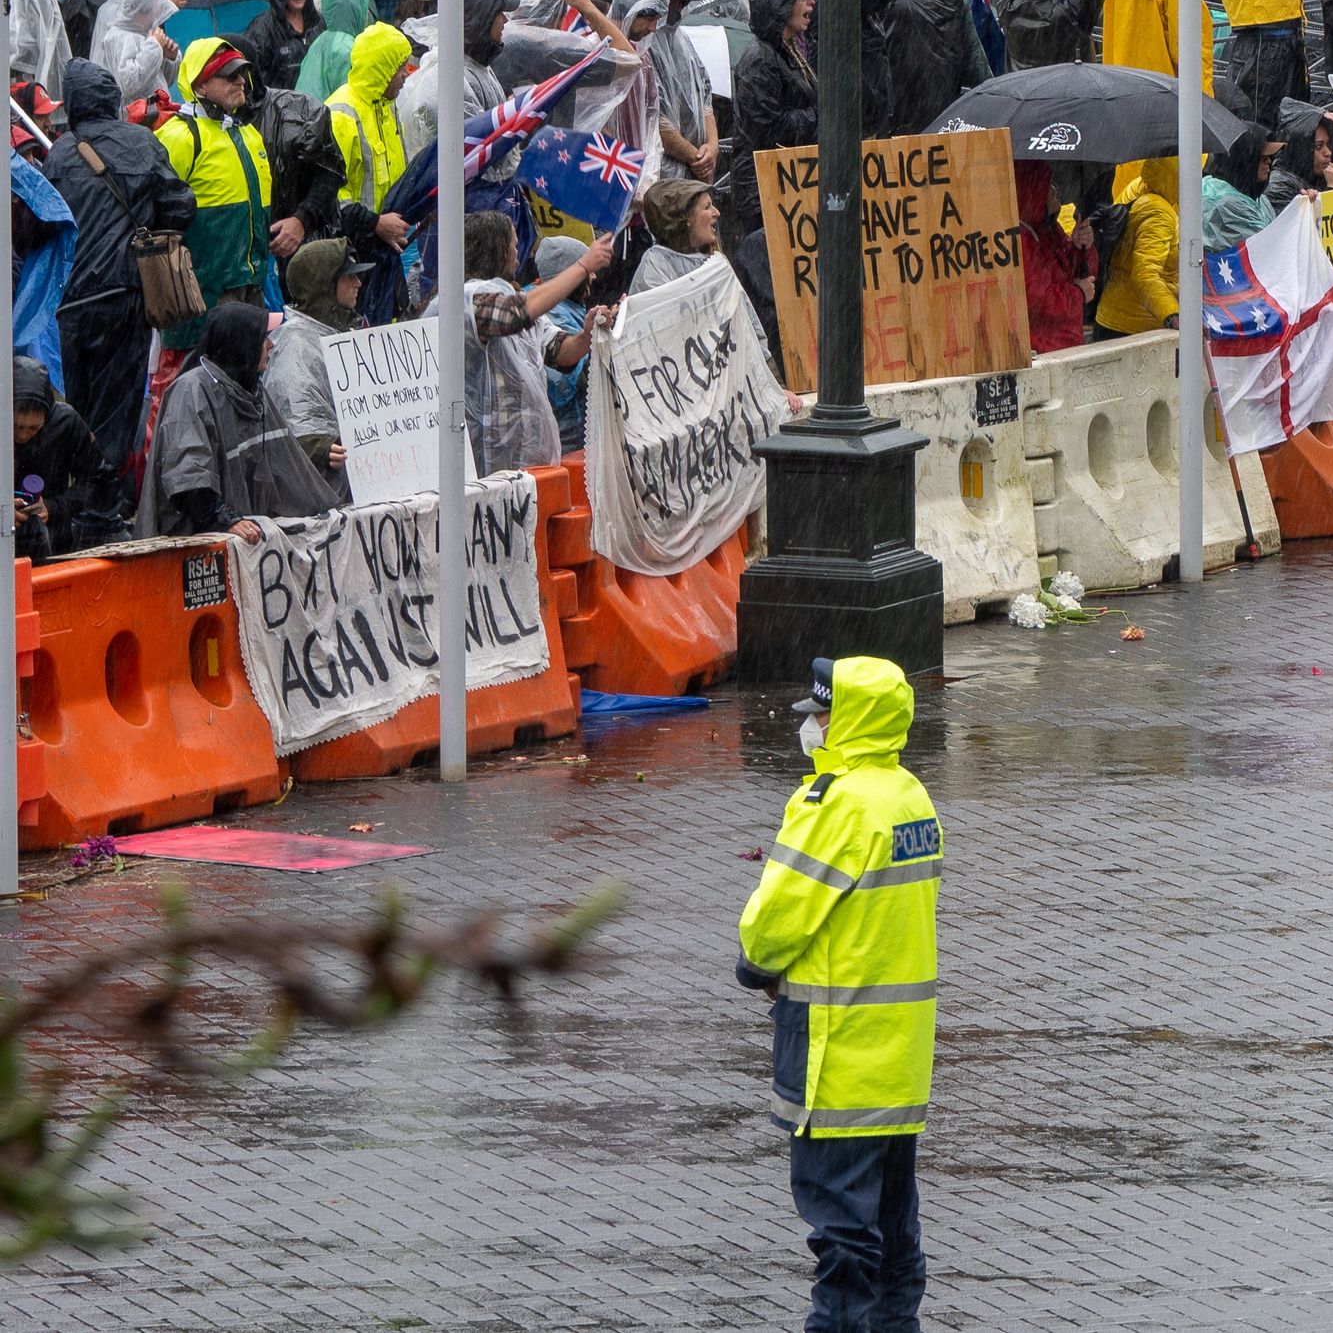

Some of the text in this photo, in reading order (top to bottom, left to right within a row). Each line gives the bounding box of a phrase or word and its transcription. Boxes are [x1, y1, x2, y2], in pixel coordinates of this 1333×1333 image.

[1028, 137, 1076, 152] 75 years
[862, 145, 950, 189] OLICE
[777, 199, 818, 253] YO
[940, 191, 963, 229] A
[893, 241, 924, 284] TO
[930, 226, 1020, 281] PROTEST
[329, 326, 439, 392] JACINDA
[340, 395, 371, 420] FROM
[372, 391, 391, 410] ONE
[393, 387, 421, 407] MOTHER
[424, 386, 434, 400] TO
[631, 356, 694, 425] FOR
[384, 421, 402, 436] OUR
[404, 415, 420, 431] NEXT
[188, 556, 219, 579] RSEA
[355, 512, 422, 594] HOW
[189, 575, 219, 590] FOR HIRE
[282, 593, 440, 713] AGAINST
[894, 823, 940, 858] POLICE
